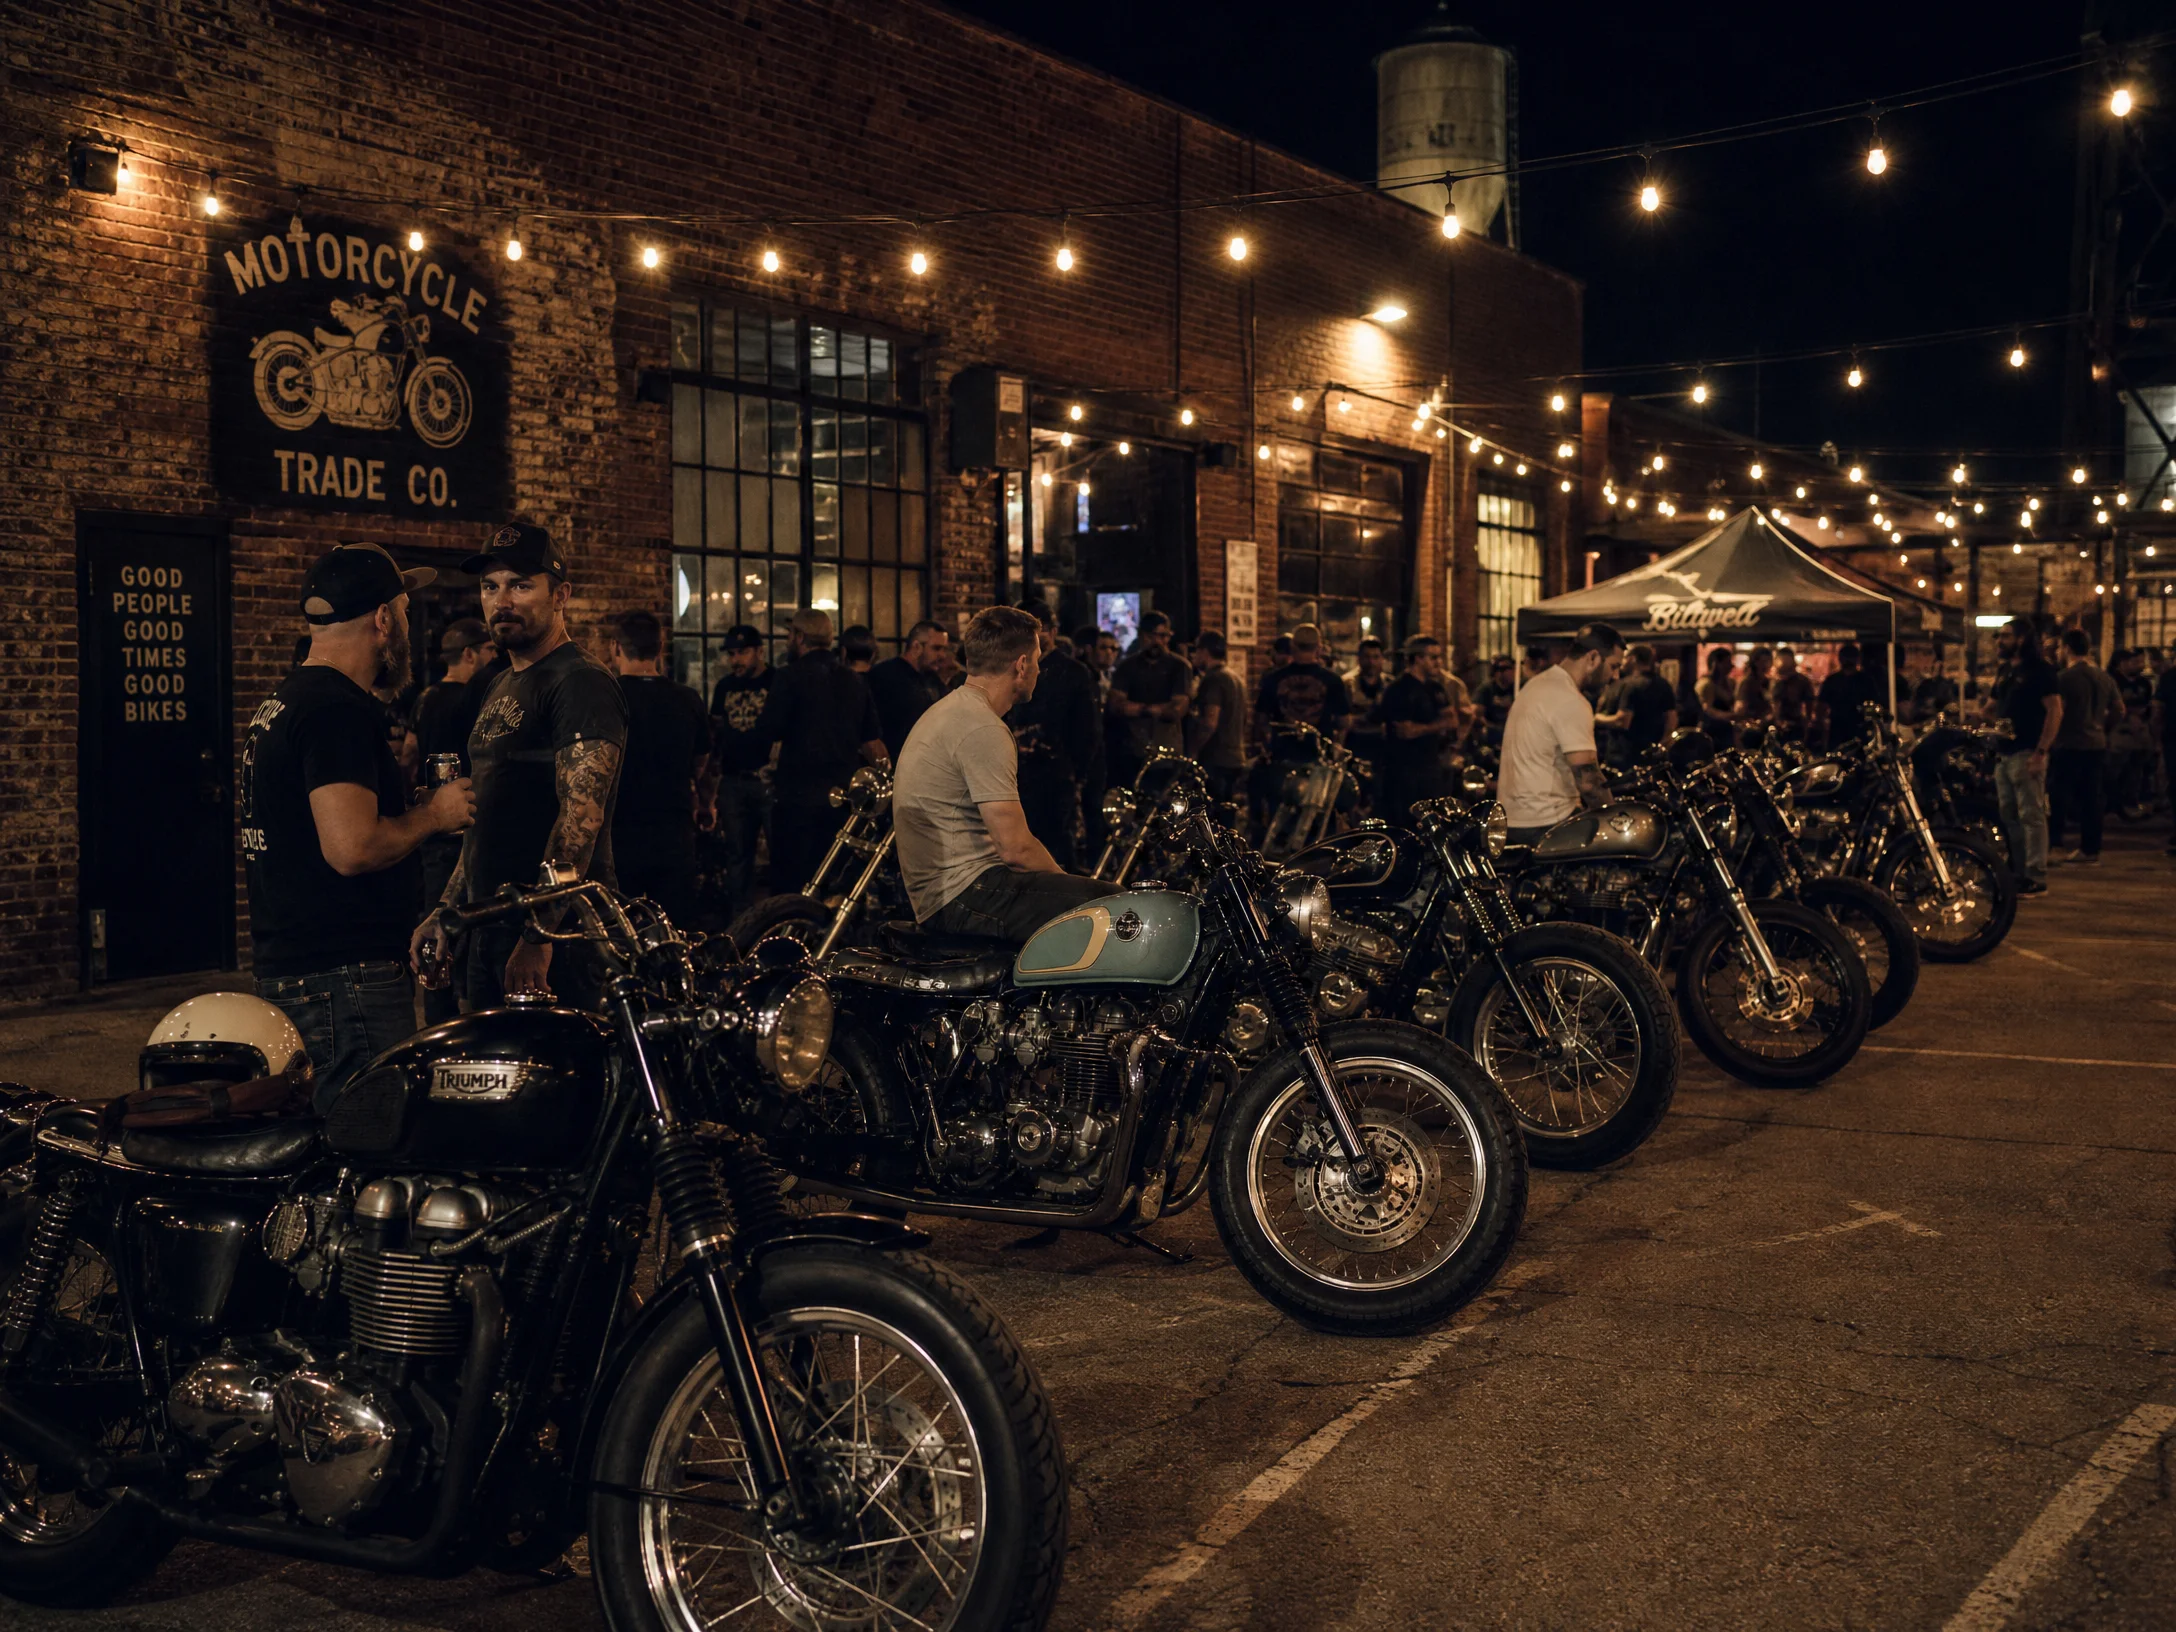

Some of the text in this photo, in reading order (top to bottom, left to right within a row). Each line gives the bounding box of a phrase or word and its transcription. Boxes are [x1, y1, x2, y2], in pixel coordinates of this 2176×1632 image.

[224, 231, 488, 335] MOTORCYCLE
[274, 449, 457, 508] TRADE CO.
[121, 565, 183, 588] GOOD
[112, 592, 193, 615] PEOPLE
[123, 619, 184, 641] GOOD
[121, 647, 187, 669] TIMES
[124, 673, 185, 695] GOOD
[124, 700, 188, 722] BIKES
[436, 1068, 507, 1094] TRIUMPH
